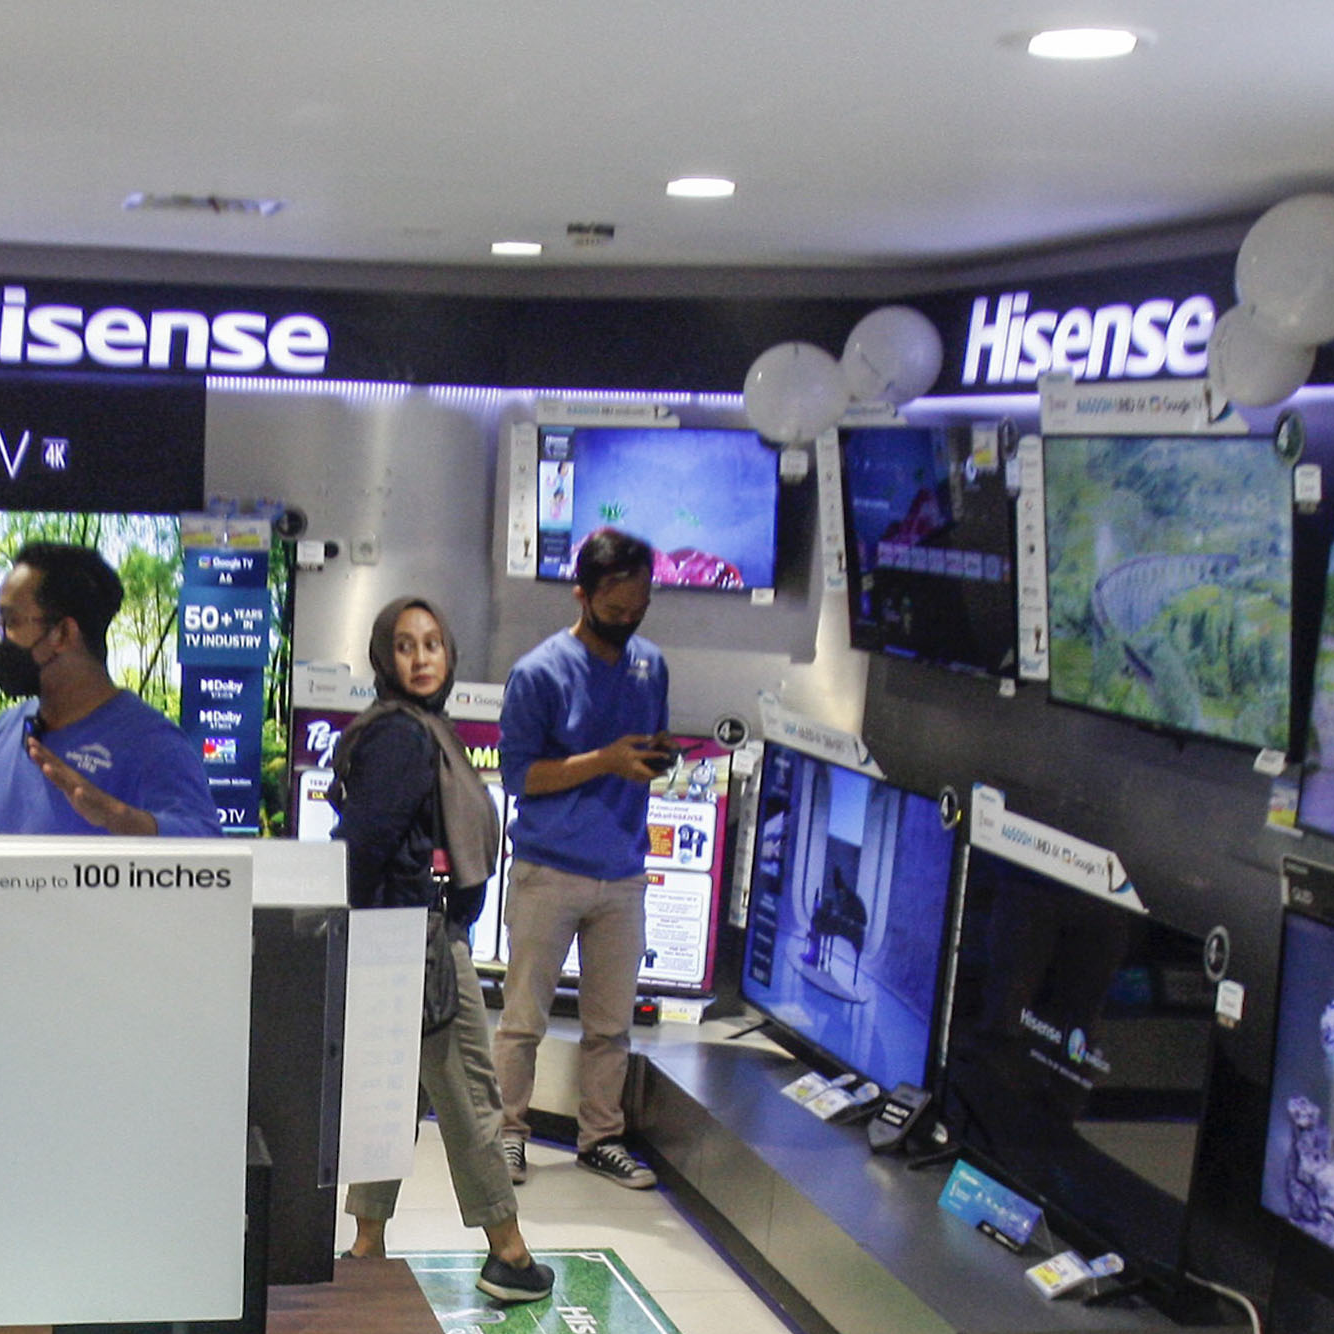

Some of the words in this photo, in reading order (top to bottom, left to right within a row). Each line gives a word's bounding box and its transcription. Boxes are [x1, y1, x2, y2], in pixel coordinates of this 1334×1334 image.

[961, 291, 1217, 384] Hisense
[213, 557, 241, 571] Google
[243, 557, 254, 570] TV
[219, 573, 232, 585] A6
[234, 609, 264, 621] YEARS
[244, 620, 254, 630] IN
[185, 634, 201, 648] TV
[202, 634, 262, 649] INDUSTRY
[215, 679, 243, 695] Dolby
[214, 710, 243, 726] Dolby
[718, 721, 732, 742] 4
[25, 877, 47, 893] up
[51, 875, 69, 888] to
[73, 863, 120, 888] 100
[129, 862, 231, 888] inches
[1020, 1007, 1063, 1045] Hisense
